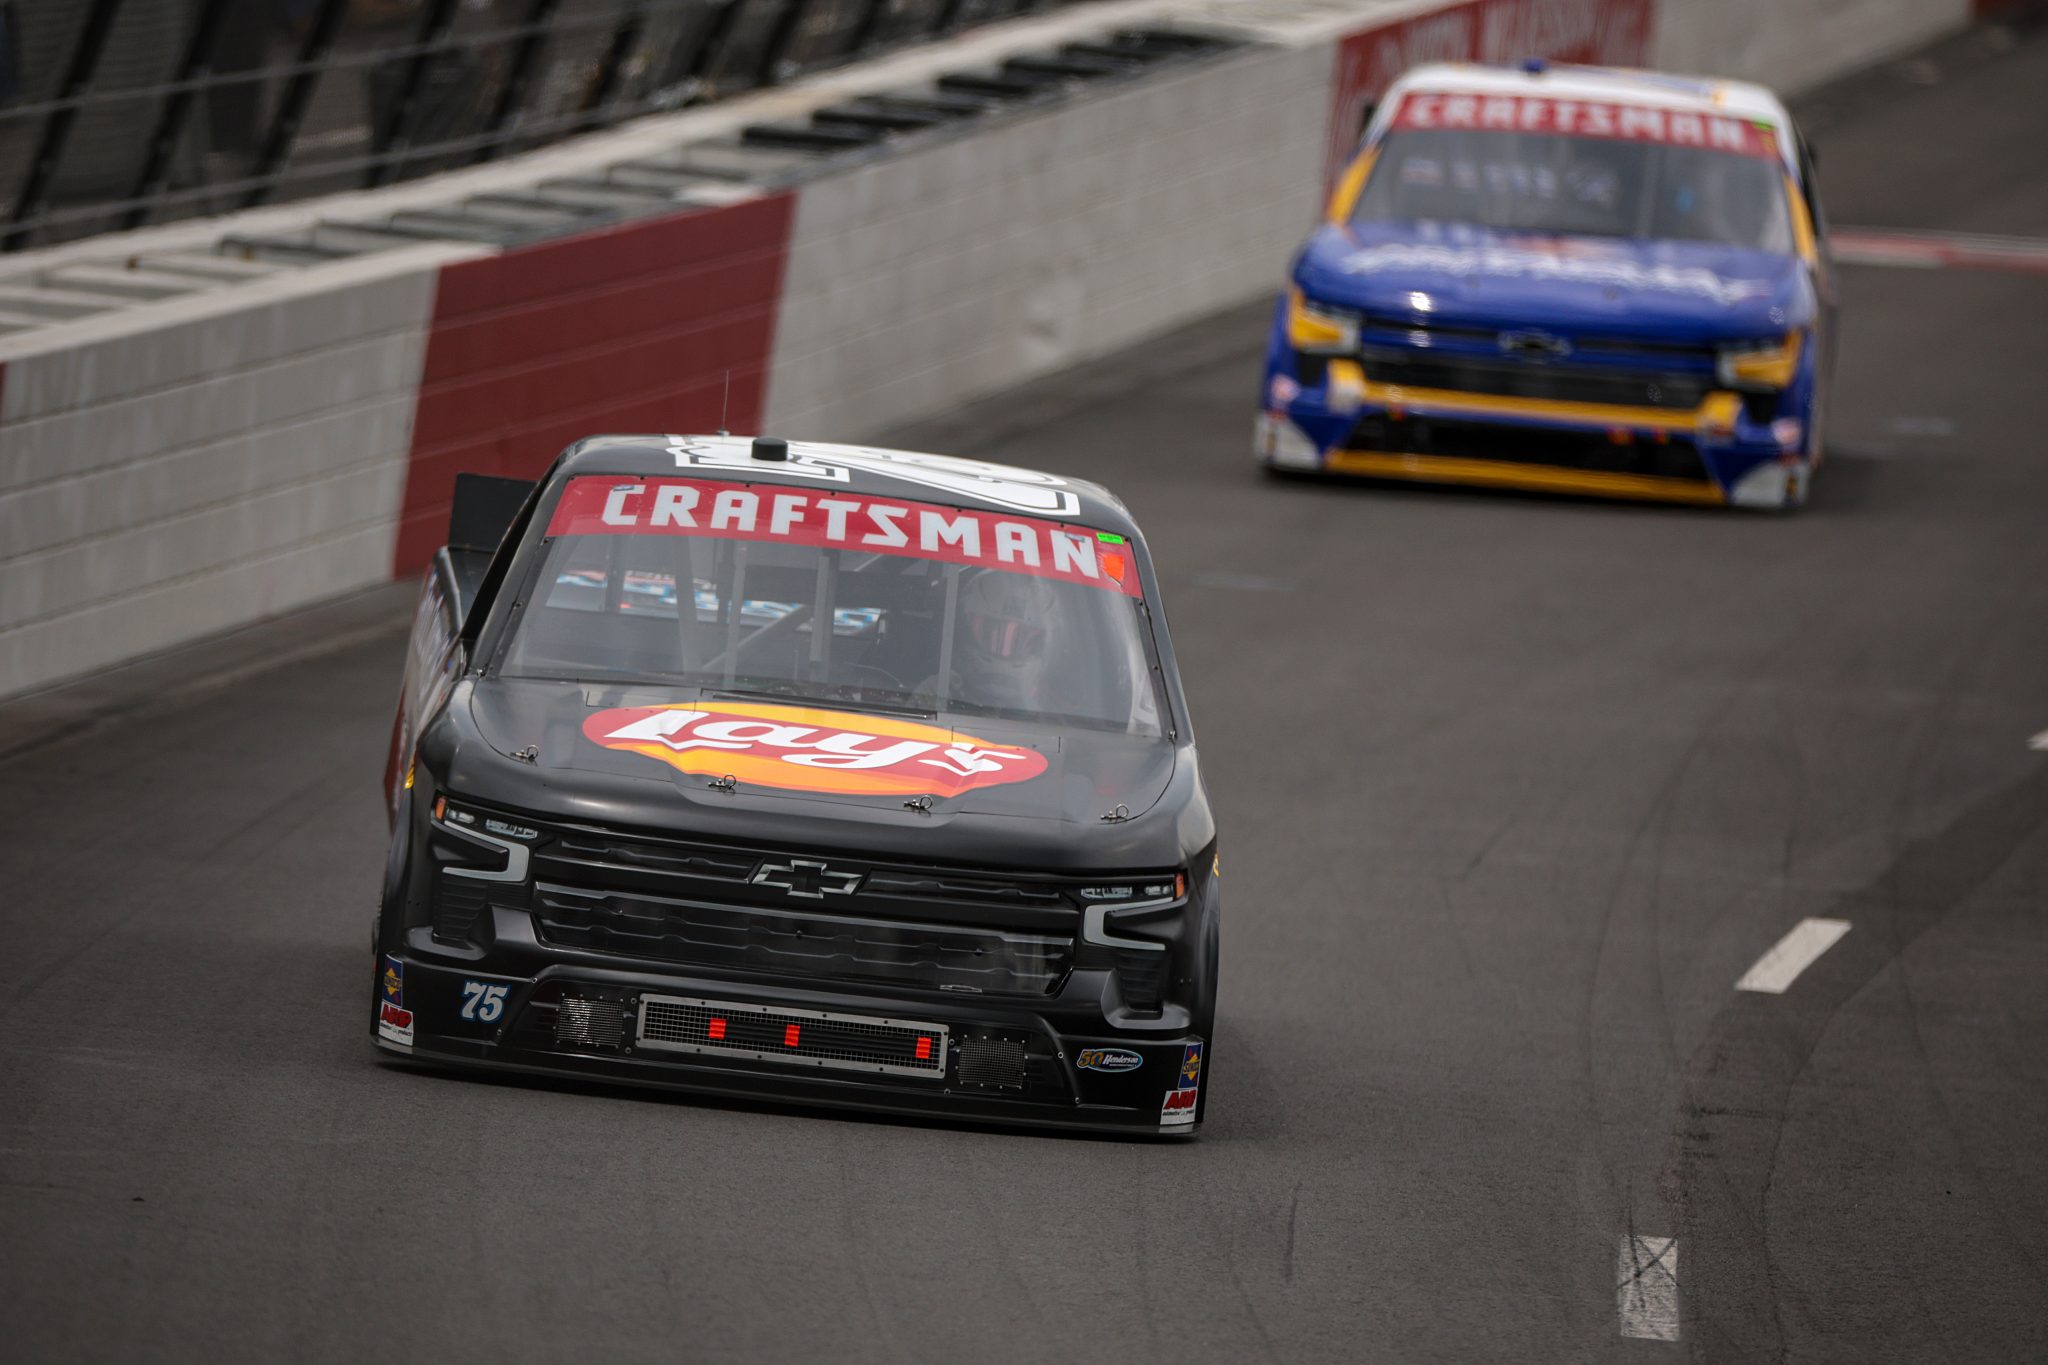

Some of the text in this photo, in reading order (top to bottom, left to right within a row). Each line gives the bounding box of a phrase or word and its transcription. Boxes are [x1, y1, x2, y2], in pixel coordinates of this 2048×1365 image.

[1410, 94, 1745, 149] CRAFTSMAN
[601, 484, 1099, 578] CRAFTSMAN
[603, 708, 1026, 777] Lay's
[461, 981, 508, 1022] 75
[1079, 1052, 1139, 1067] 50 Henderson
